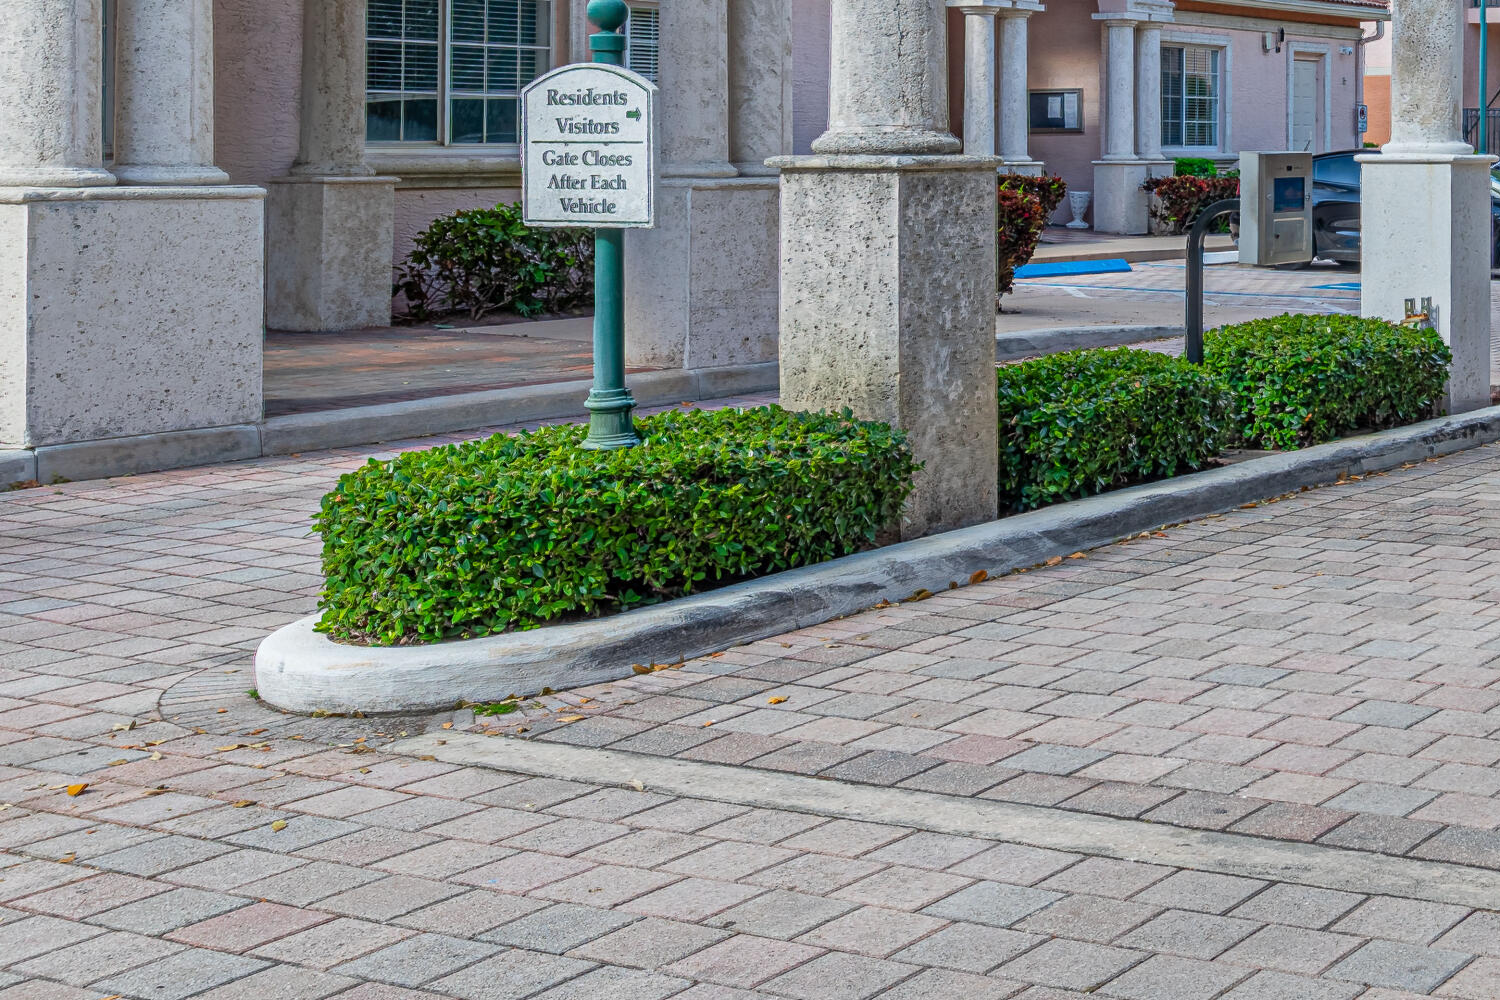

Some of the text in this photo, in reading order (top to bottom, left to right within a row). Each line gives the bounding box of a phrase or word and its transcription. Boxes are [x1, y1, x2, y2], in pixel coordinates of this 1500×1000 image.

[547, 88, 628, 106] Residents
[555, 117, 620, 134] Visitors
[542, 150, 633, 167] Gate Closes
[547, 173, 627, 190] After Each
[560, 197, 617, 214] Vehicle
